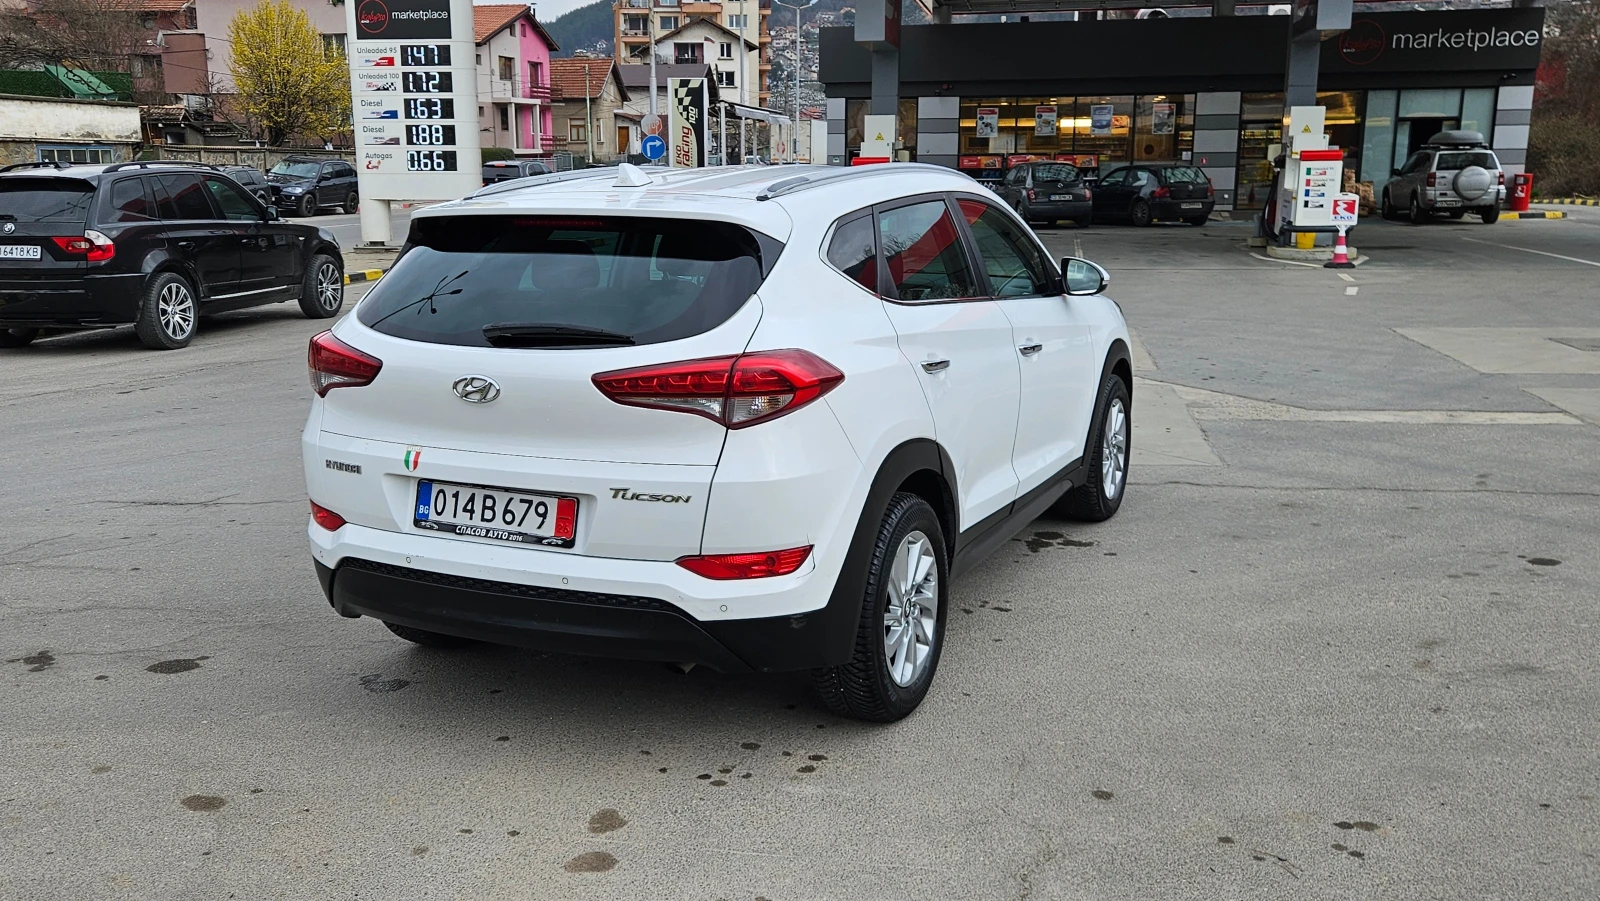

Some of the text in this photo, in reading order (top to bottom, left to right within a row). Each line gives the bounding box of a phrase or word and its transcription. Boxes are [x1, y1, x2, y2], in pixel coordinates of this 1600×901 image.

[391, 9, 448, 21] marketplace
[1392, 26, 1540, 52] marketplace
[407, 44, 439, 66] 1.47
[409, 72, 440, 93] 1.72
[361, 99, 383, 107] Diesel
[410, 98, 442, 119] 1.63
[688, 106, 696, 124] 100
[362, 125, 385, 133] Diesel
[412, 124, 443, 145] 1.88
[682, 126, 693, 167] racing
[365, 152, 393, 160] Autogas
[407, 150, 445, 171] 0.66
[0, 246, 39, 257] 6418KB
[325, 459, 363, 475] HYUNDAI
[418, 488, 549, 530] BG 014B679
[455, 525, 524, 542] СПАСОВ АУТО 2016
[557, 522, 570, 534] 26
